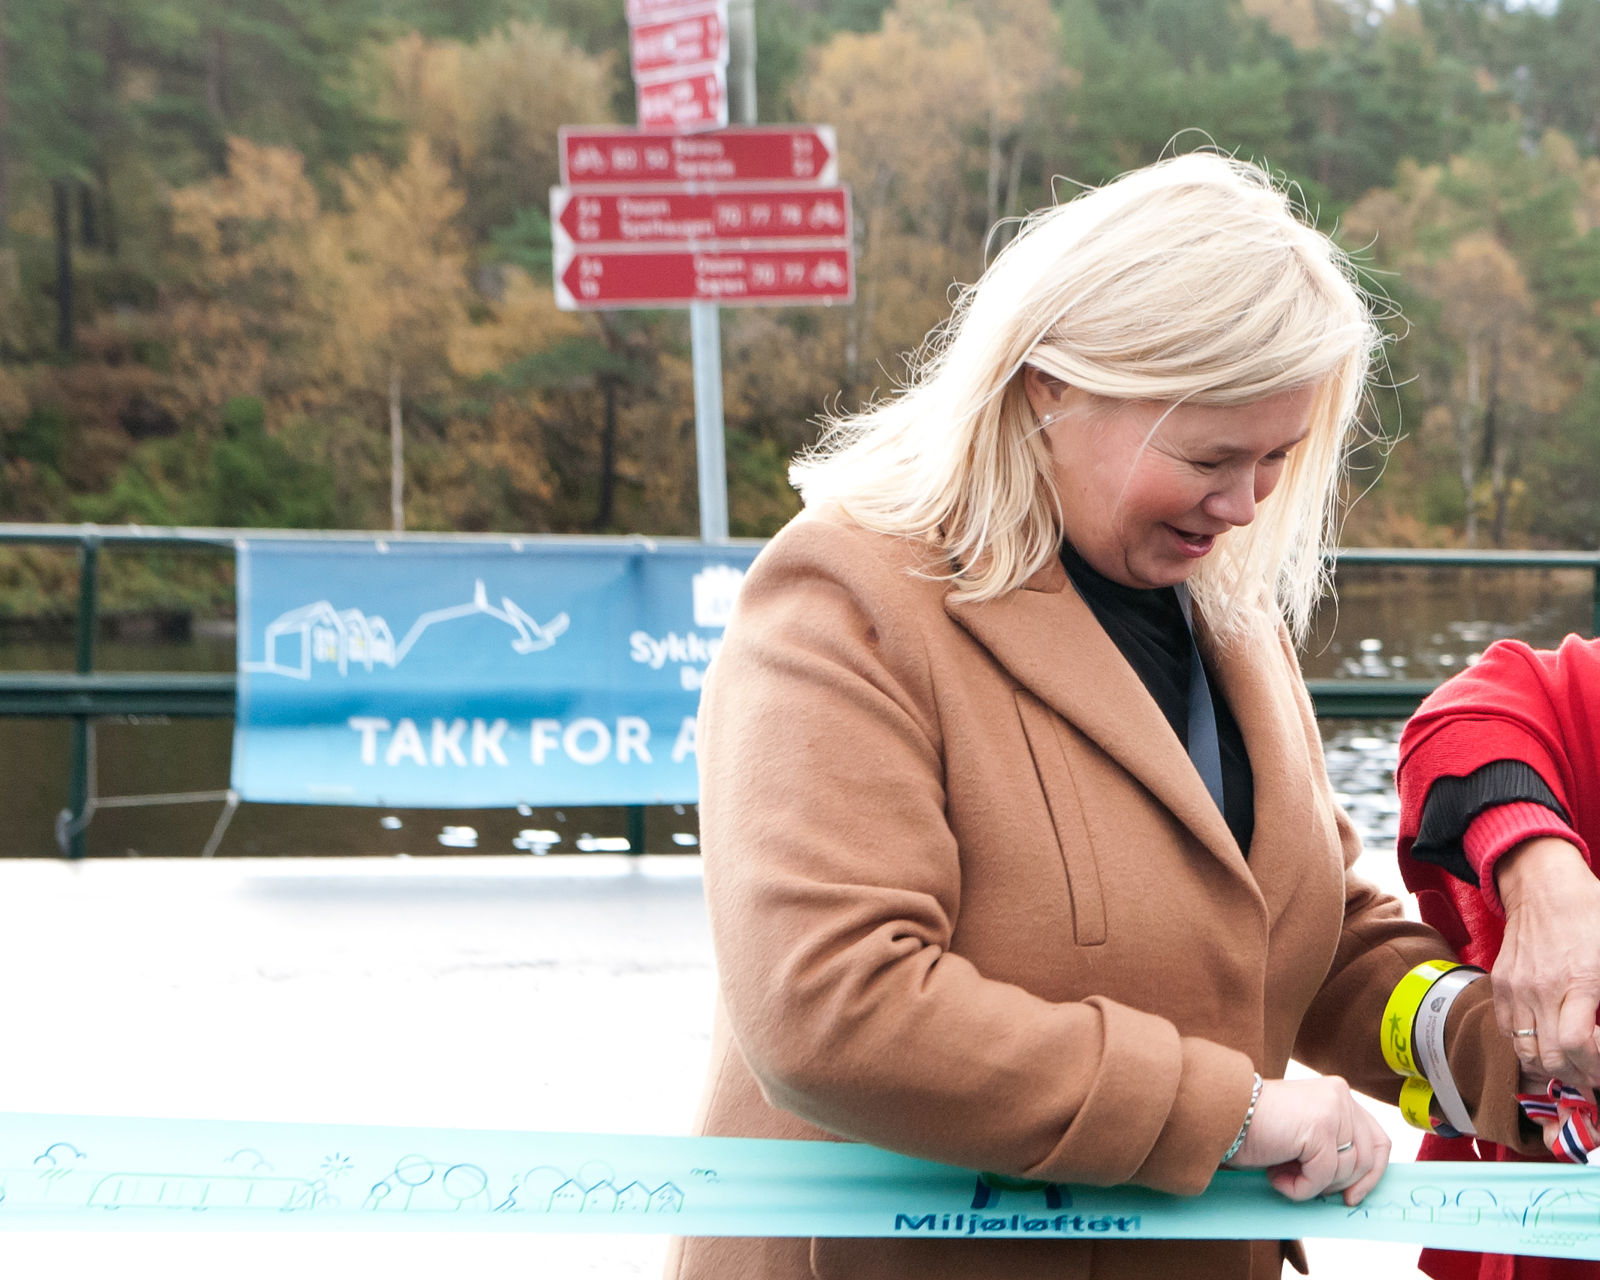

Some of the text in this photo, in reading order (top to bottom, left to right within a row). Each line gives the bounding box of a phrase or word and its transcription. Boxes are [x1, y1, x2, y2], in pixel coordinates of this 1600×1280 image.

[349, 717, 509, 766] TAKK
[530, 716, 653, 765] FOR
[895, 1213, 1136, 1235] Miljøløftet
